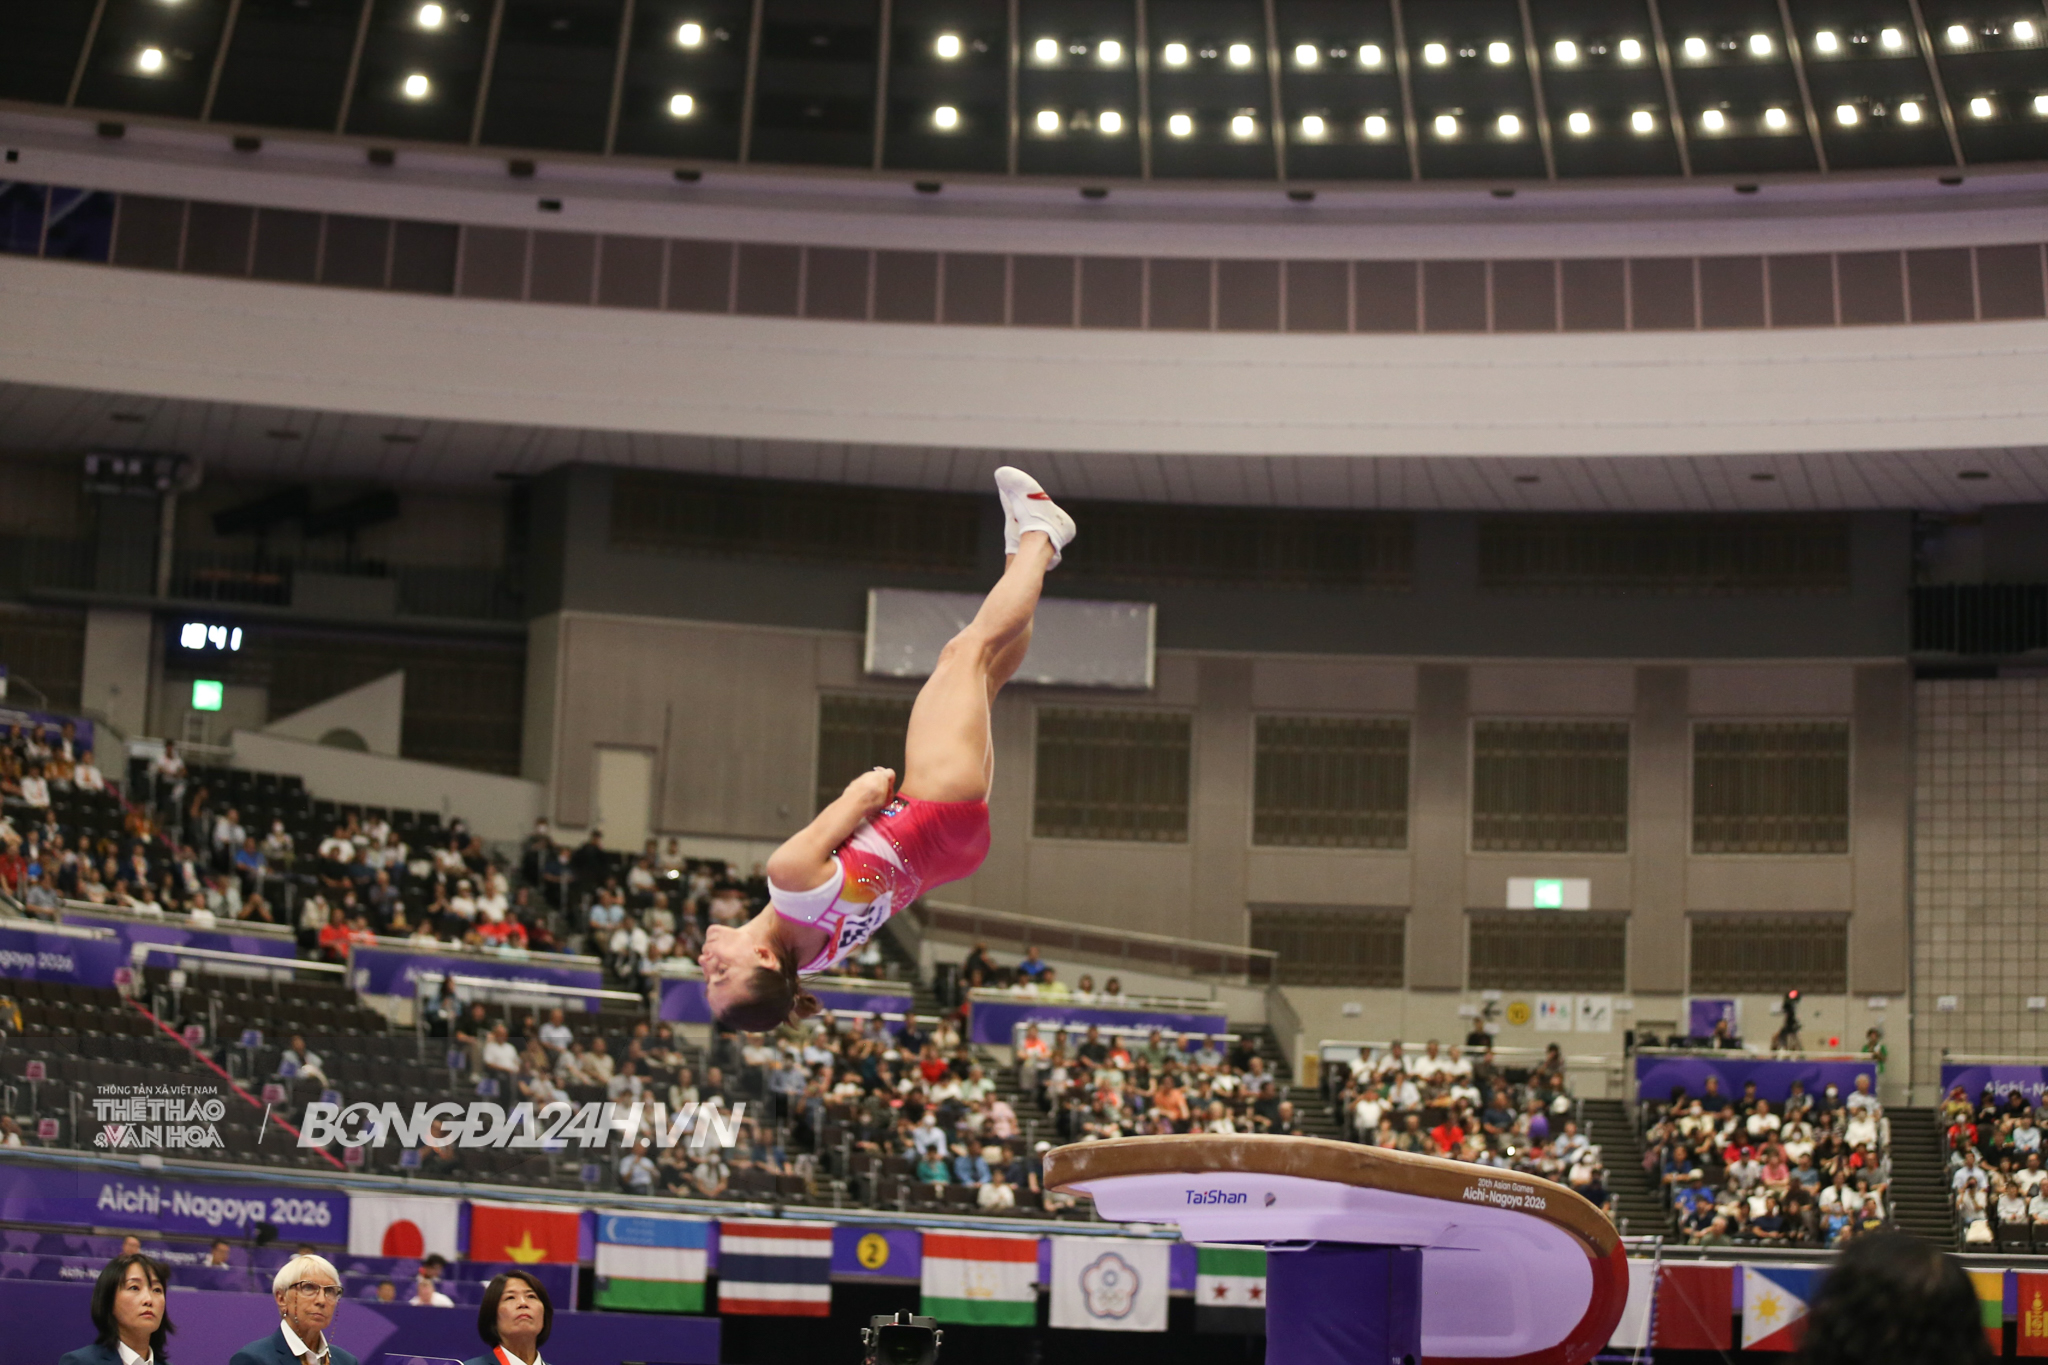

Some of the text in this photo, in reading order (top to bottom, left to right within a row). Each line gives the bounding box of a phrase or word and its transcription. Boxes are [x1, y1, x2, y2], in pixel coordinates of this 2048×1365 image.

[1478, 1178, 1534, 1194] 20th Asian Games
[97, 1183, 332, 1228] Aichi-Nagoya 2026
[1186, 1189, 1247, 1204] TaiShan
[1463, 1187, 1546, 1209] Aichi-Nagoya 2026
[866, 1244, 878, 1263] 2
